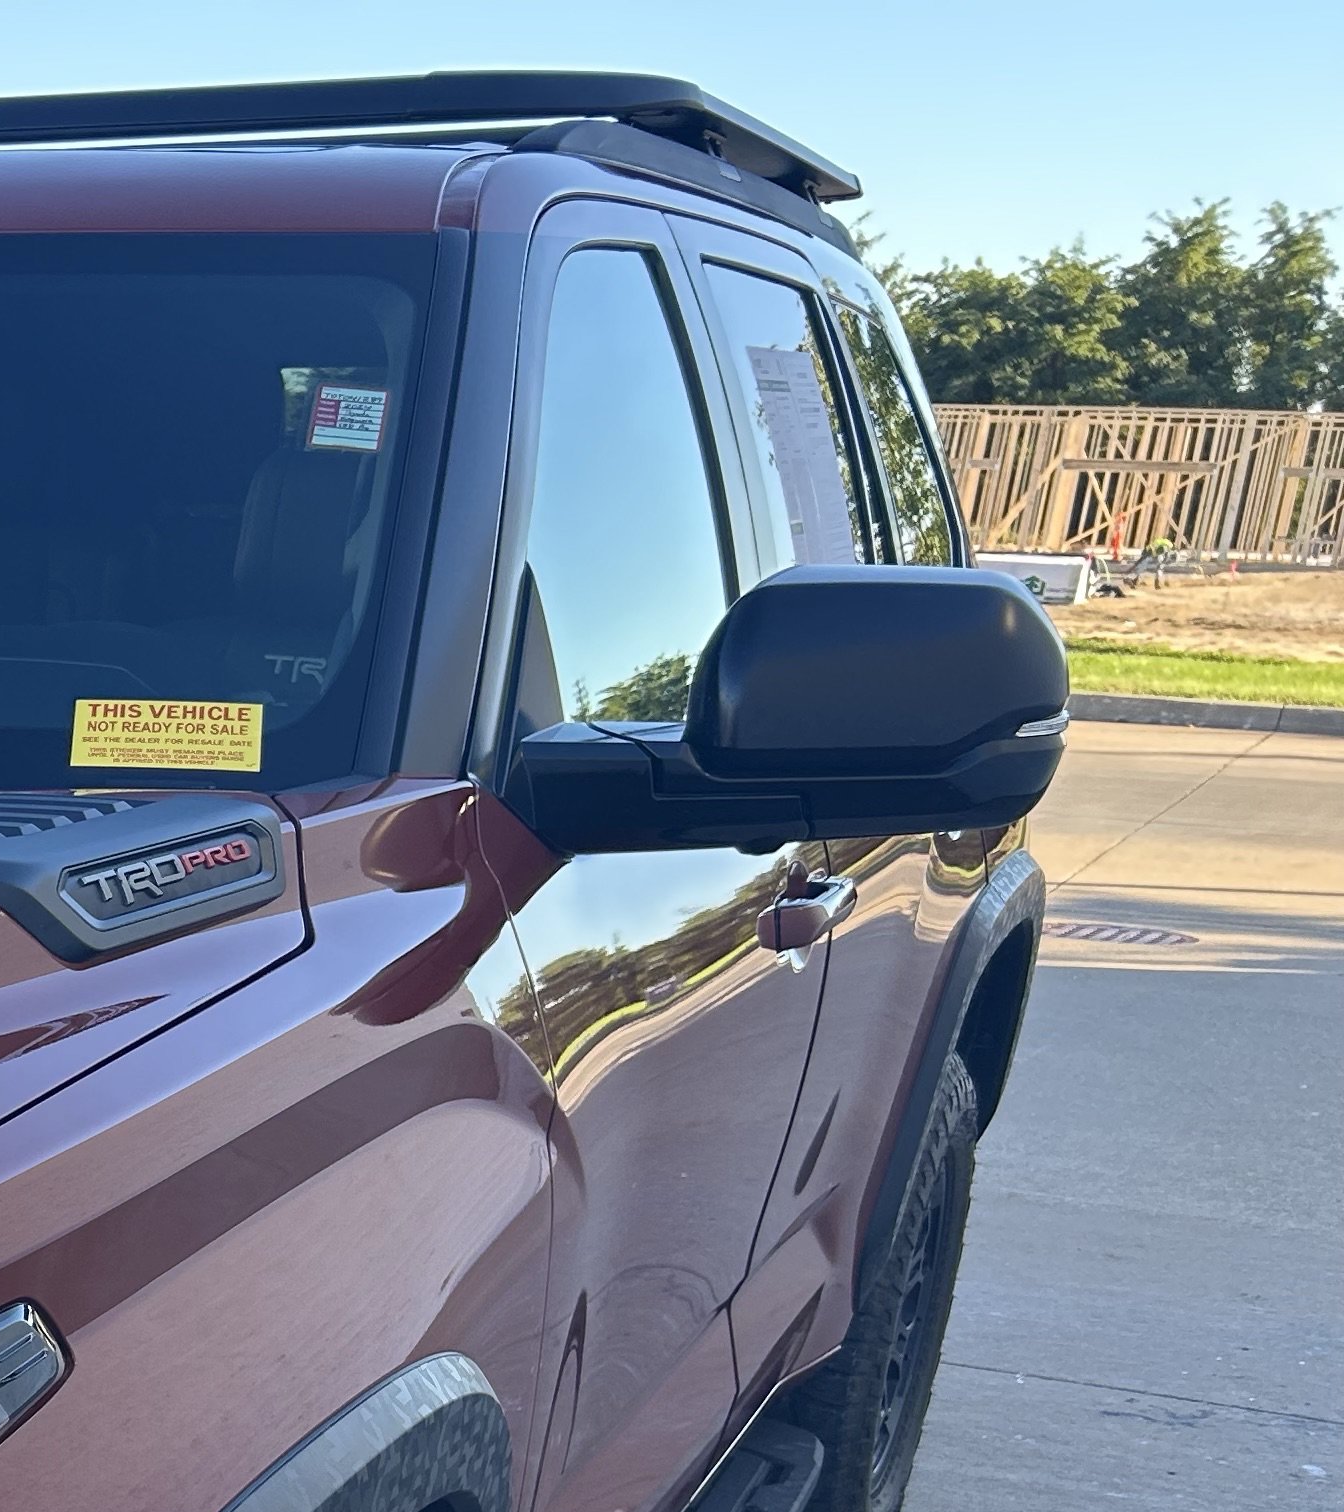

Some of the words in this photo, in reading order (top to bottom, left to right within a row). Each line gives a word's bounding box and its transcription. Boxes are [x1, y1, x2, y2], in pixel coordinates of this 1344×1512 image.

[88, 703, 142, 719] THIS
[149, 704, 251, 722] VEHICLE
[87, 720, 118, 732] NOT
[121, 721, 172, 734] READY
[175, 722, 206, 735] FOR
[210, 723, 249, 736] SALE
[124, 736, 160, 744] DEALER
[229, 739, 253, 747] DATE
